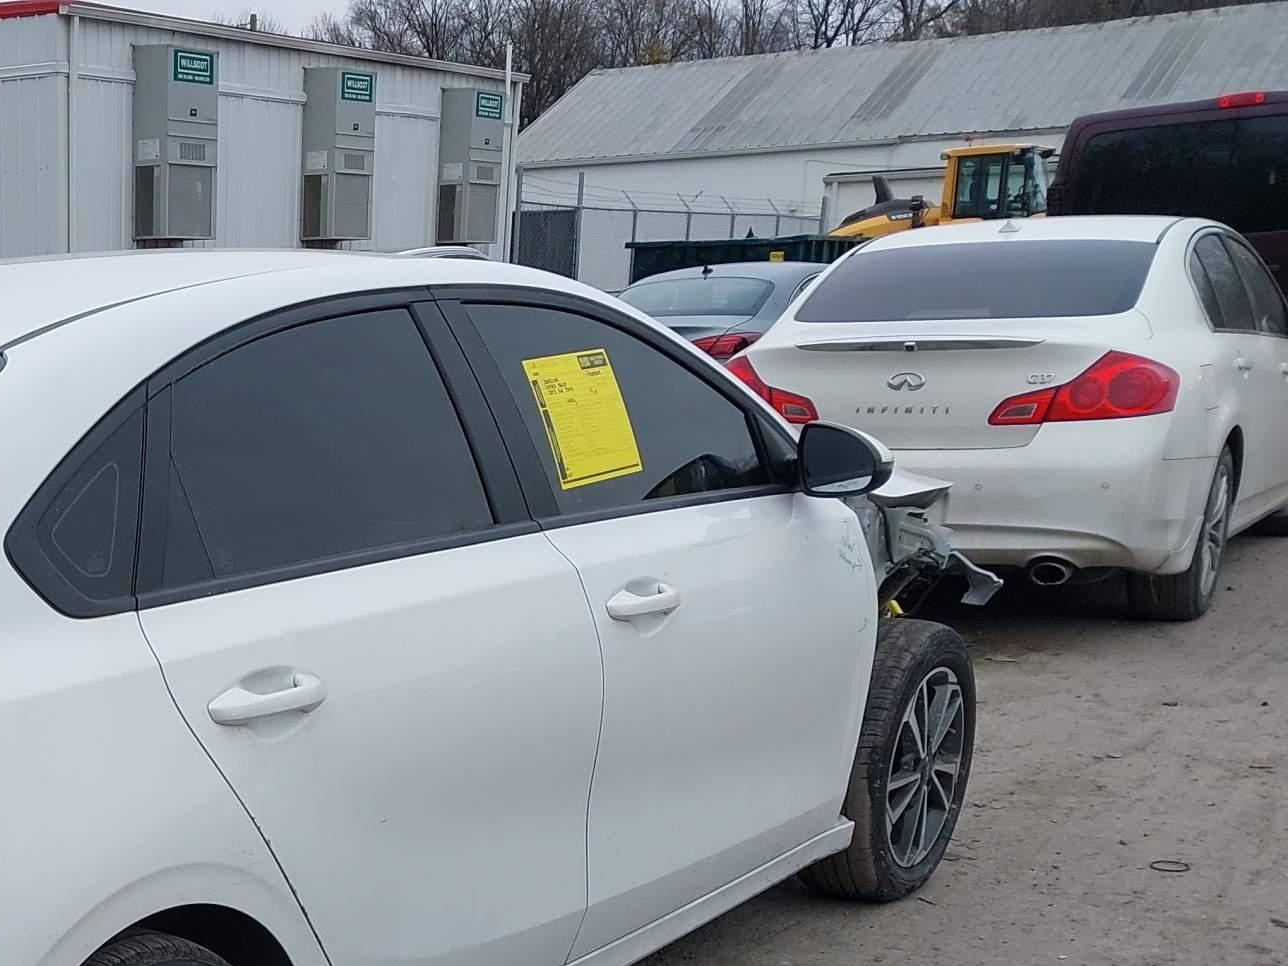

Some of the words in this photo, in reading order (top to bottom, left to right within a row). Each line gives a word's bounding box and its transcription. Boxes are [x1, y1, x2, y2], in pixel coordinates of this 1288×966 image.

[180, 58, 208, 70] WILLSCOT
[347, 79, 369, 89] WILLSCOT
[1026, 373, 1056, 385] G37
[855, 405, 950, 415] INFINITI
